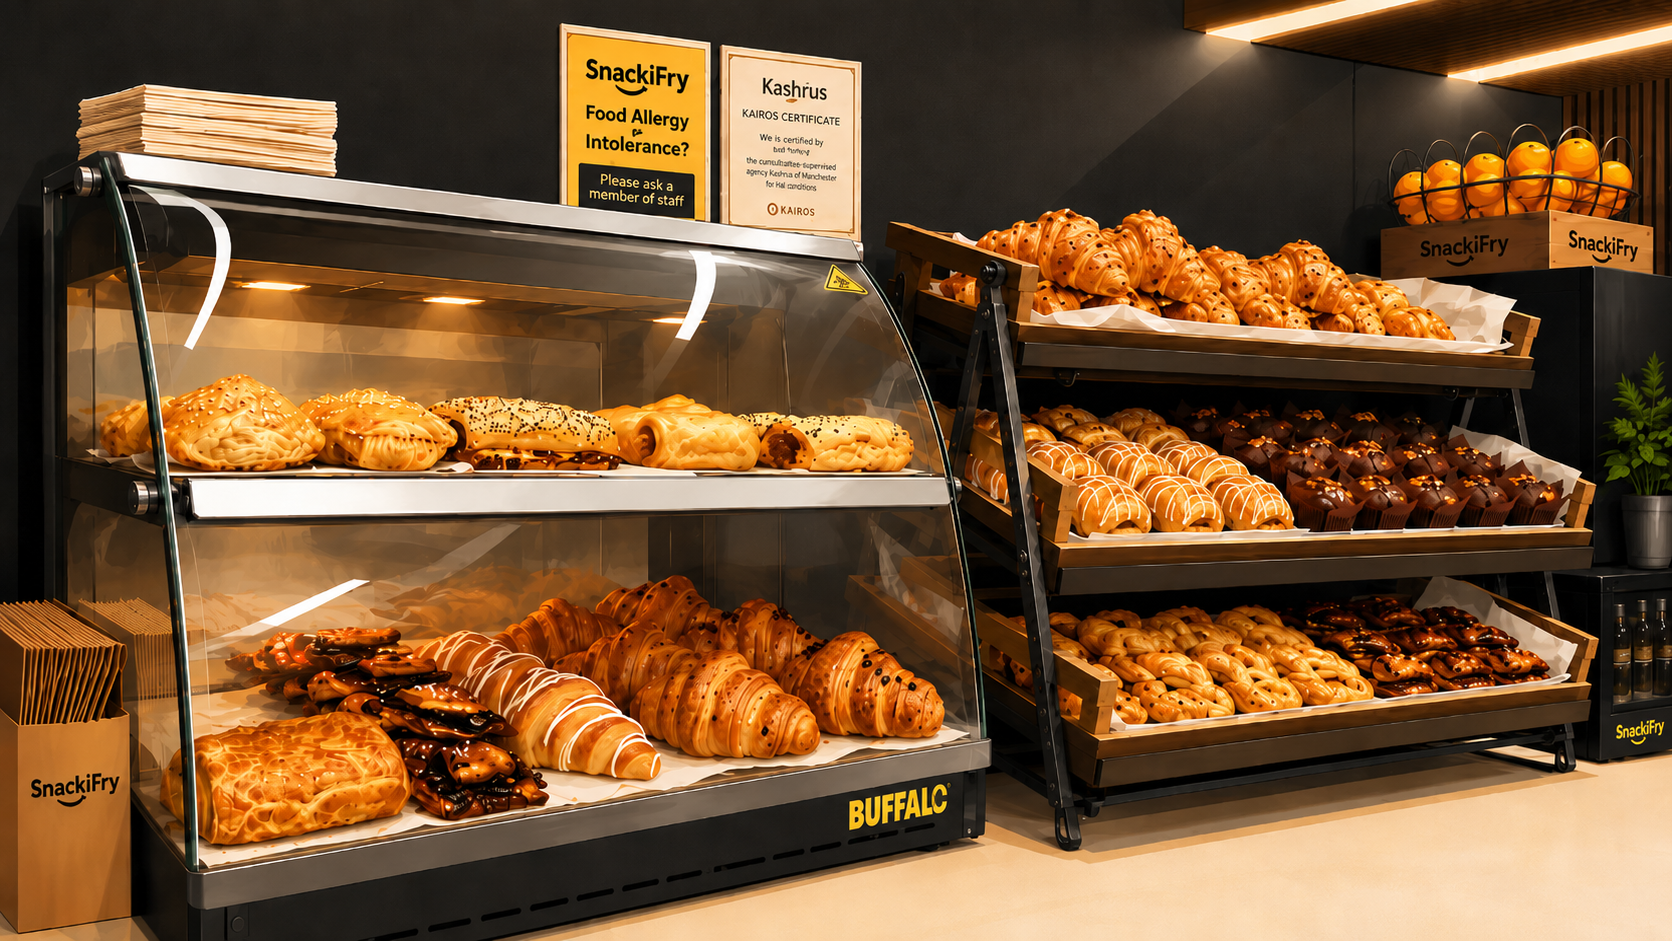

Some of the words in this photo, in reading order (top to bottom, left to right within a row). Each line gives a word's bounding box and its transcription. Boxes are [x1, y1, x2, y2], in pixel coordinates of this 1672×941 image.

[586, 58, 689, 94] SnackiFry
[762, 77, 827, 101] Kashrus
[586, 104, 626, 123] Food
[631, 108, 689, 132] Allergy
[742, 108, 778, 121] KAIROS
[781, 112, 840, 126] CERTIFICATE
[586, 133, 689, 157] Intolerance?
[759, 133, 773, 142] We
[775, 134, 781, 142] is
[783, 136, 813, 146] certified
[815, 138, 824, 147] by
[746, 156, 757, 165] the
[600, 173, 640, 188] Please
[643, 178, 663, 191] ask
[666, 182, 673, 192] a
[746, 168, 768, 178] agency
[794, 171, 801, 179] of
[802, 172, 837, 182] Manchester
[766, 180, 775, 188] for
[589, 189, 639, 203] member
[643, 193, 655, 204] of
[657, 195, 684, 207] staff
[780, 205, 815, 217] KAIROS
[1420, 234, 1509, 257] SnackiFry
[1568, 229, 1638, 262] SnackiFry
[1615, 719, 1665, 739] SnackiFry
[31, 773, 120, 798] SnackiFry
